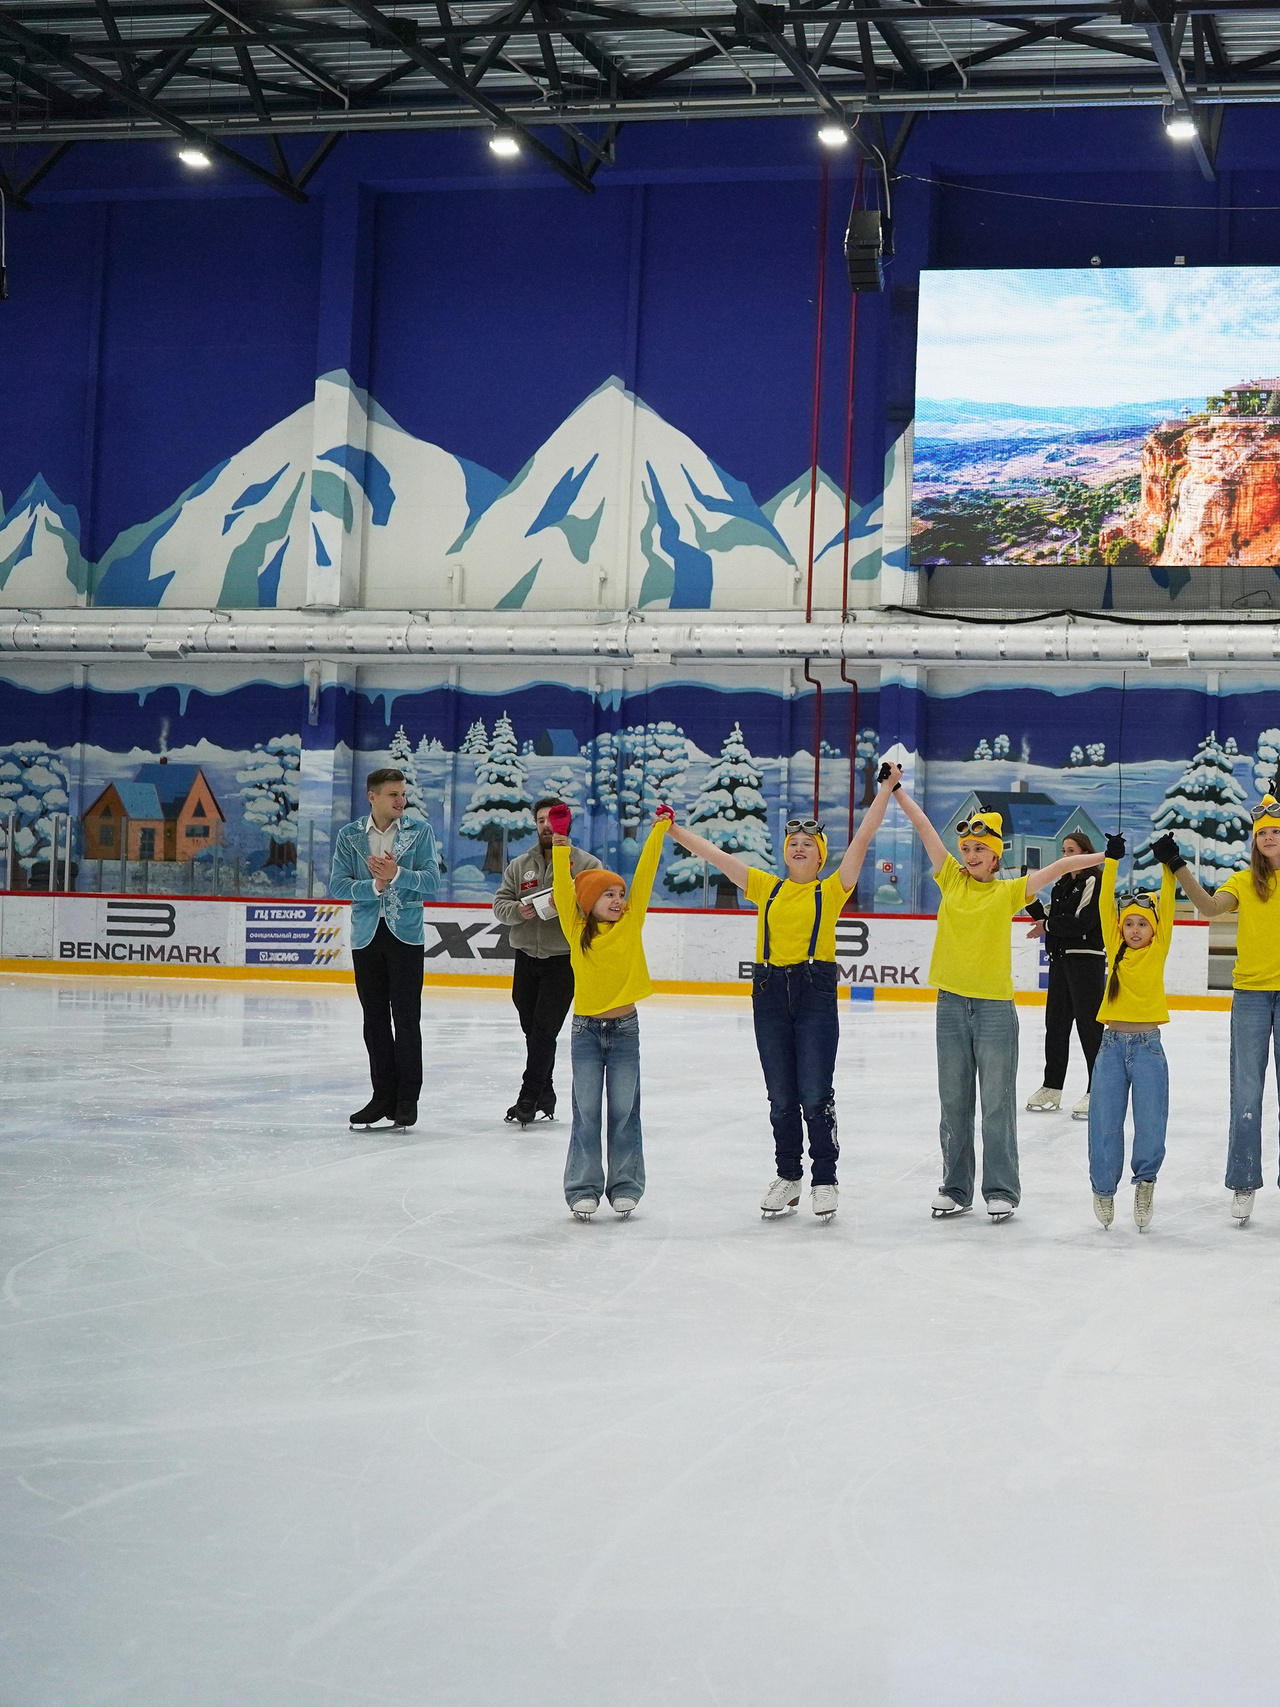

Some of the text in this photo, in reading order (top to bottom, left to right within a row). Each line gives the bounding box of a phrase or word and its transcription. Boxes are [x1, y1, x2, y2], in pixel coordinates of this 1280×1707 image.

[254, 909, 307, 921] ГЦ ТЕХНО
[249, 931, 292, 939] ОФИЦИАЛЬНЫЙ
[60, 941, 221, 964] BENCHMARK
